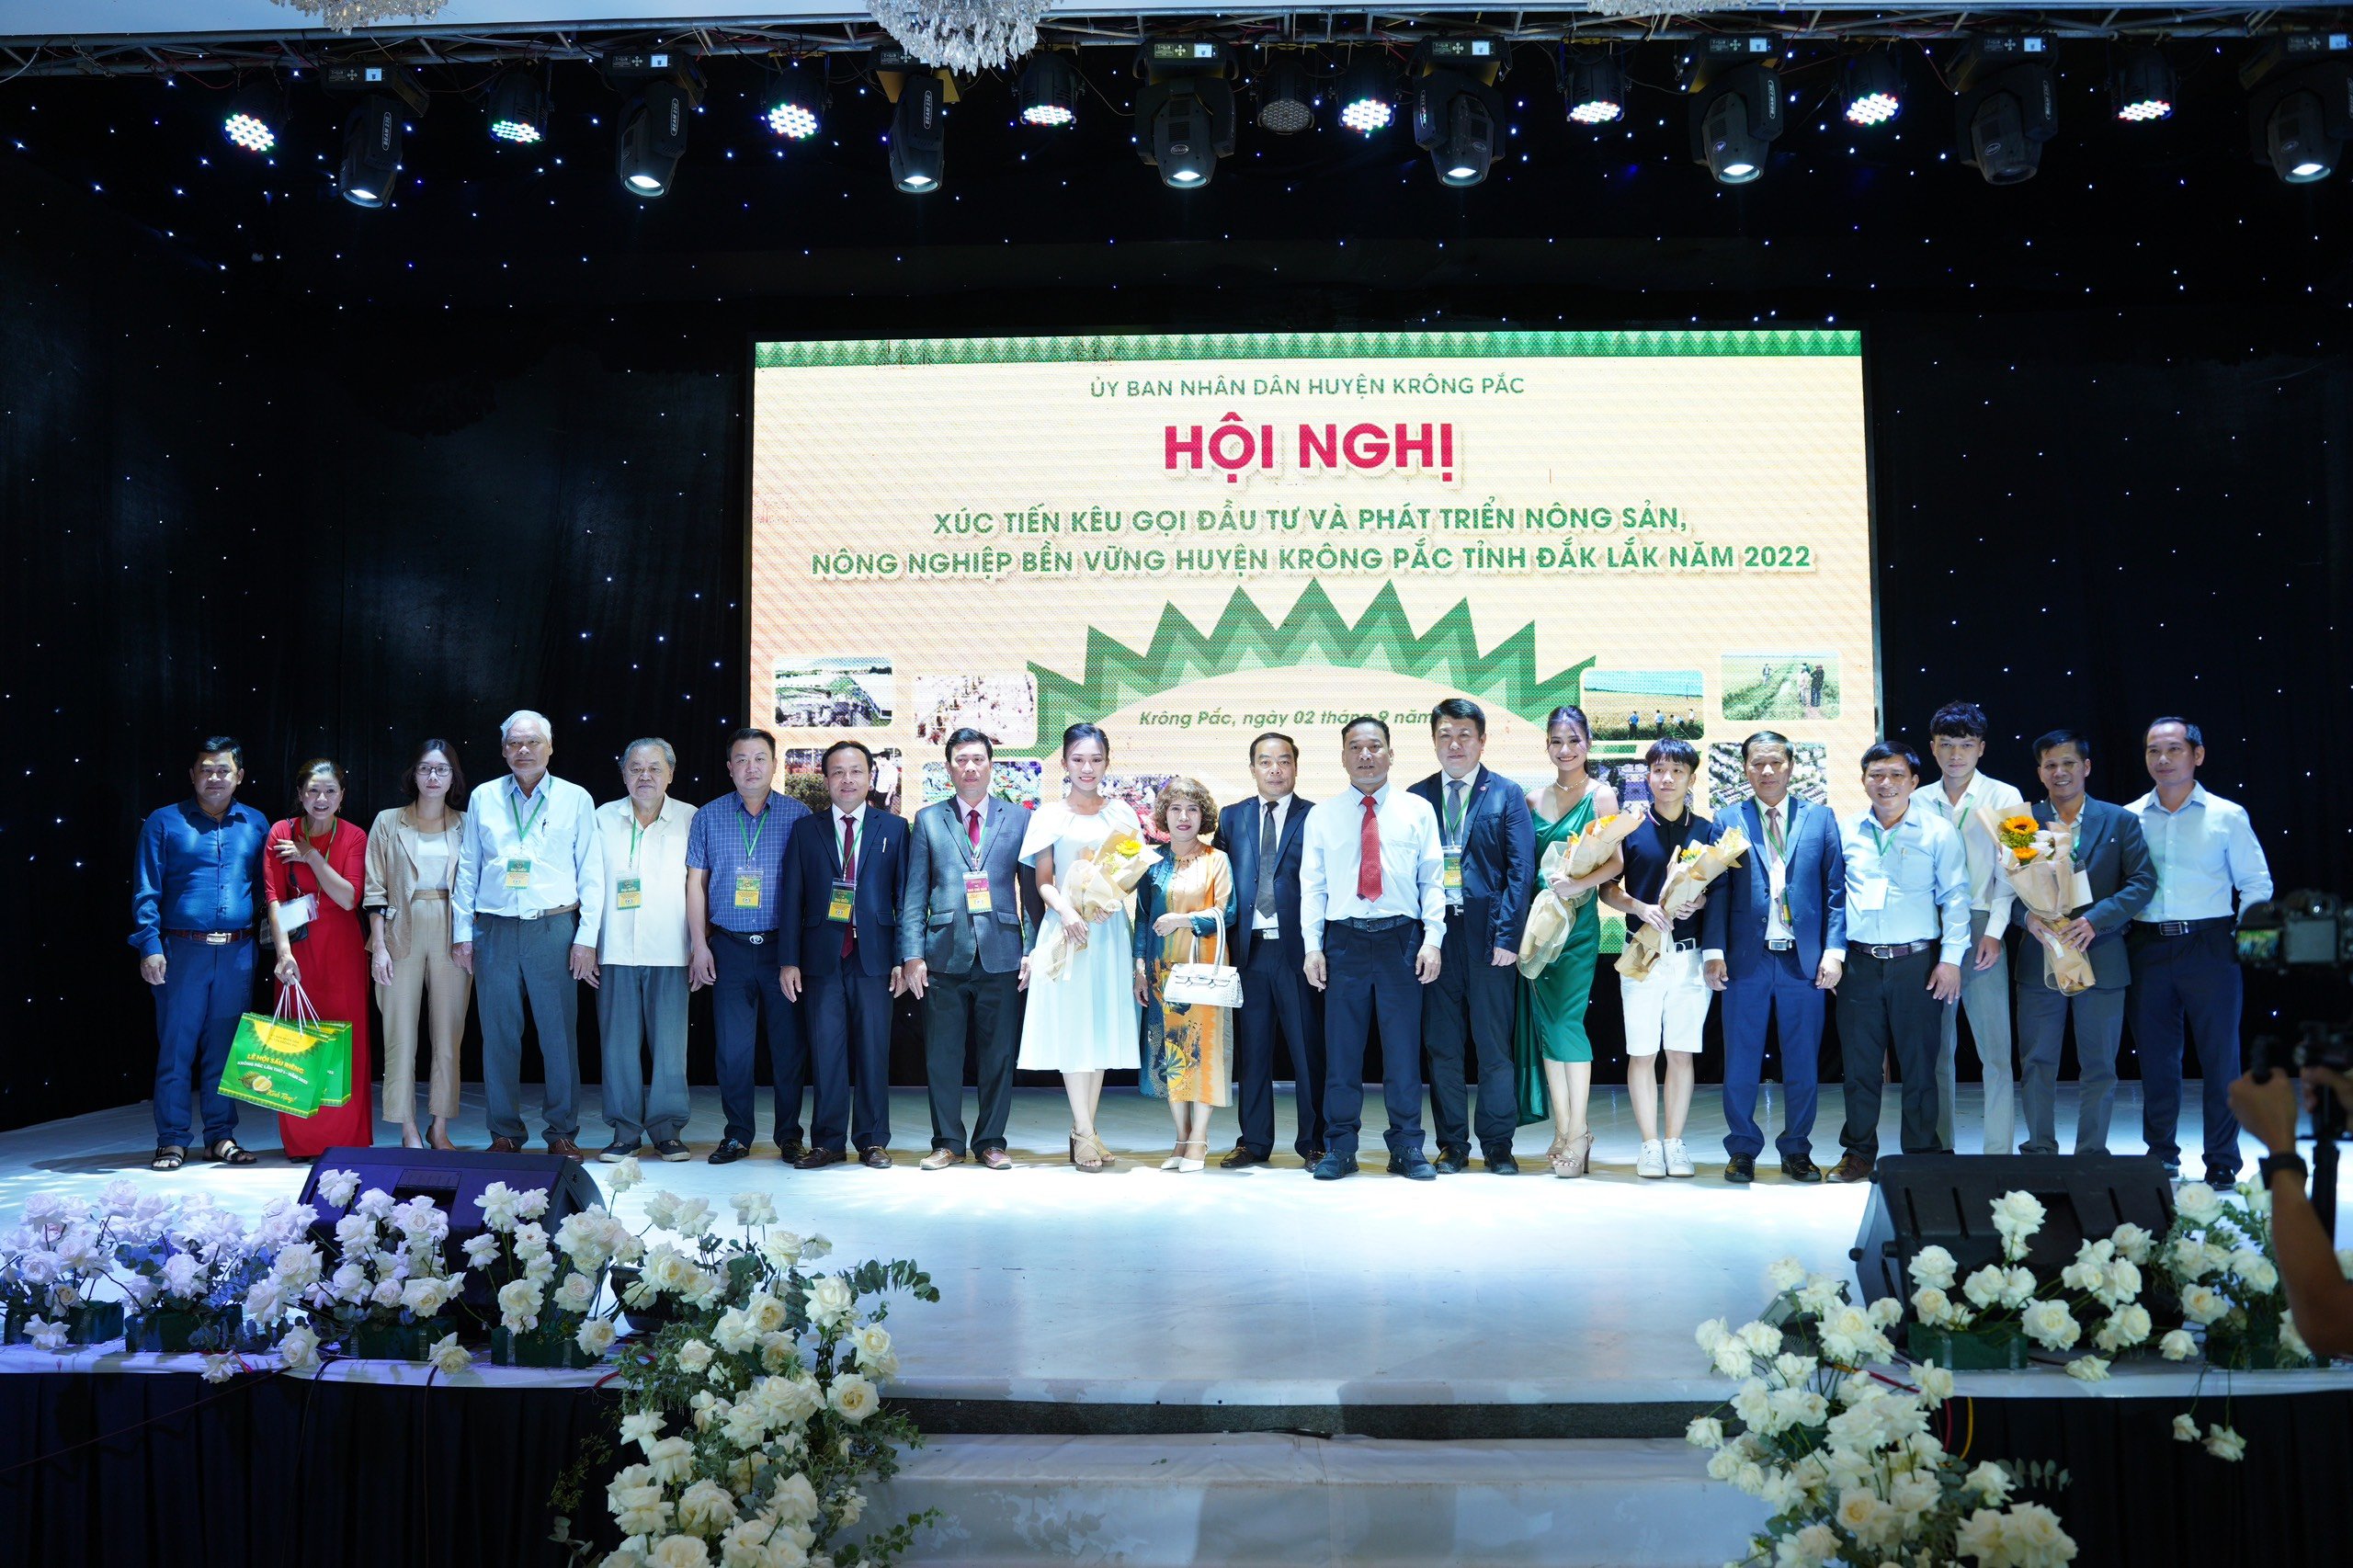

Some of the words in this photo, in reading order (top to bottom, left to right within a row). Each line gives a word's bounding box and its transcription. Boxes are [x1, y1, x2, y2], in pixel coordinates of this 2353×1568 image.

[1091, 377, 1122, 398] ỦY
[1127, 380, 1174, 396] BAN
[1180, 375, 1245, 396] NHÂN
[1254, 375, 1301, 396] DÂN
[1309, 373, 1385, 399] HUYỆN
[1392, 373, 1475, 394] KRÔNG
[1482, 371, 1526, 394] PẮC
[1165, 412, 1274, 483] HỘI
[1299, 423, 1454, 483] NGHỊ
[934, 507, 995, 534] XÚC
[1004, 502, 1062, 534] TIẾN
[1071, 506, 1121, 533] KÊU
[1132, 509, 1187, 537] GỌI
[1197, 499, 1257, 532] ĐẦU
[1267, 507, 1302, 531] TƯ
[1310, 503, 1351, 530] VÀ
[1358, 502, 1431, 530] PHÁT
[1438, 495, 1516, 530] TRIỂN
[1525, 502, 1613, 529] NÔNG
[1621, 499, 1688, 533] SẢN,
[811, 548, 898, 575] NÔNG
[908, 546, 1013, 579] NGHIỆP
[1021, 540, 1074, 574] BỀN
[1084, 545, 1166, 572] VỮNG
[1176, 544, 1268, 576] HUYỆN
[1279, 540, 1383, 571] KRÔNG
[1392, 537, 1454, 570] PẮC
[1462, 539, 1528, 570] TỈNH
[1535, 536, 1597, 569] ĐẮK
[1607, 536, 1660, 569] LẮK
[1668, 539, 1735, 568] NĂM
[1744, 545, 1812, 568] 2022
[1139, 710, 1193, 729] Krông
[1198, 707, 1236, 727] Pắc,
[1243, 710, 1288, 727] ngày
[1293, 711, 1315, 724] 02
[1393, 710, 1433, 724] năm
